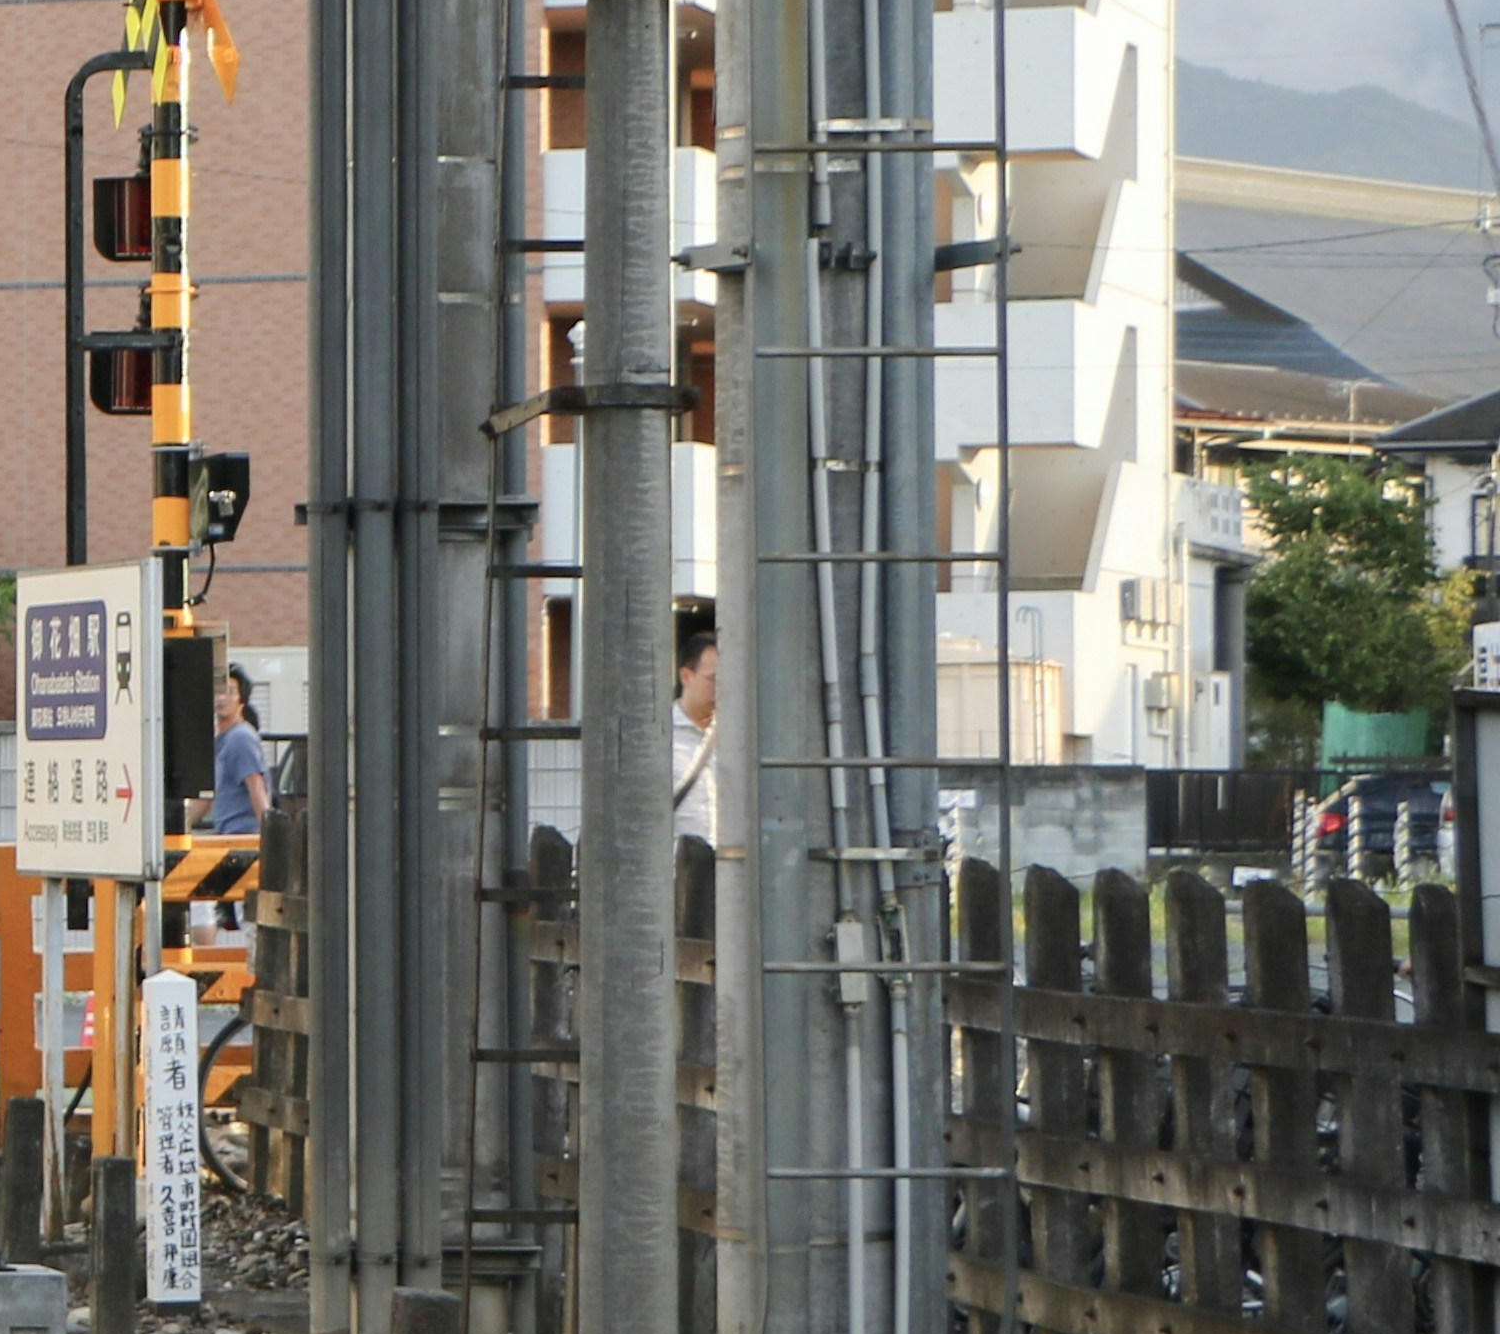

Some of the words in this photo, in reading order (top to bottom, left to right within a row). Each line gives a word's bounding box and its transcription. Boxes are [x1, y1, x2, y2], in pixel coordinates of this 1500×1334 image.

[31, 613, 101, 661] 御花畑駅
[75, 669, 101, 694] Station
[24, 758, 108, 804] 連絡通路
[159, 1003, 187, 1091] 請願者
